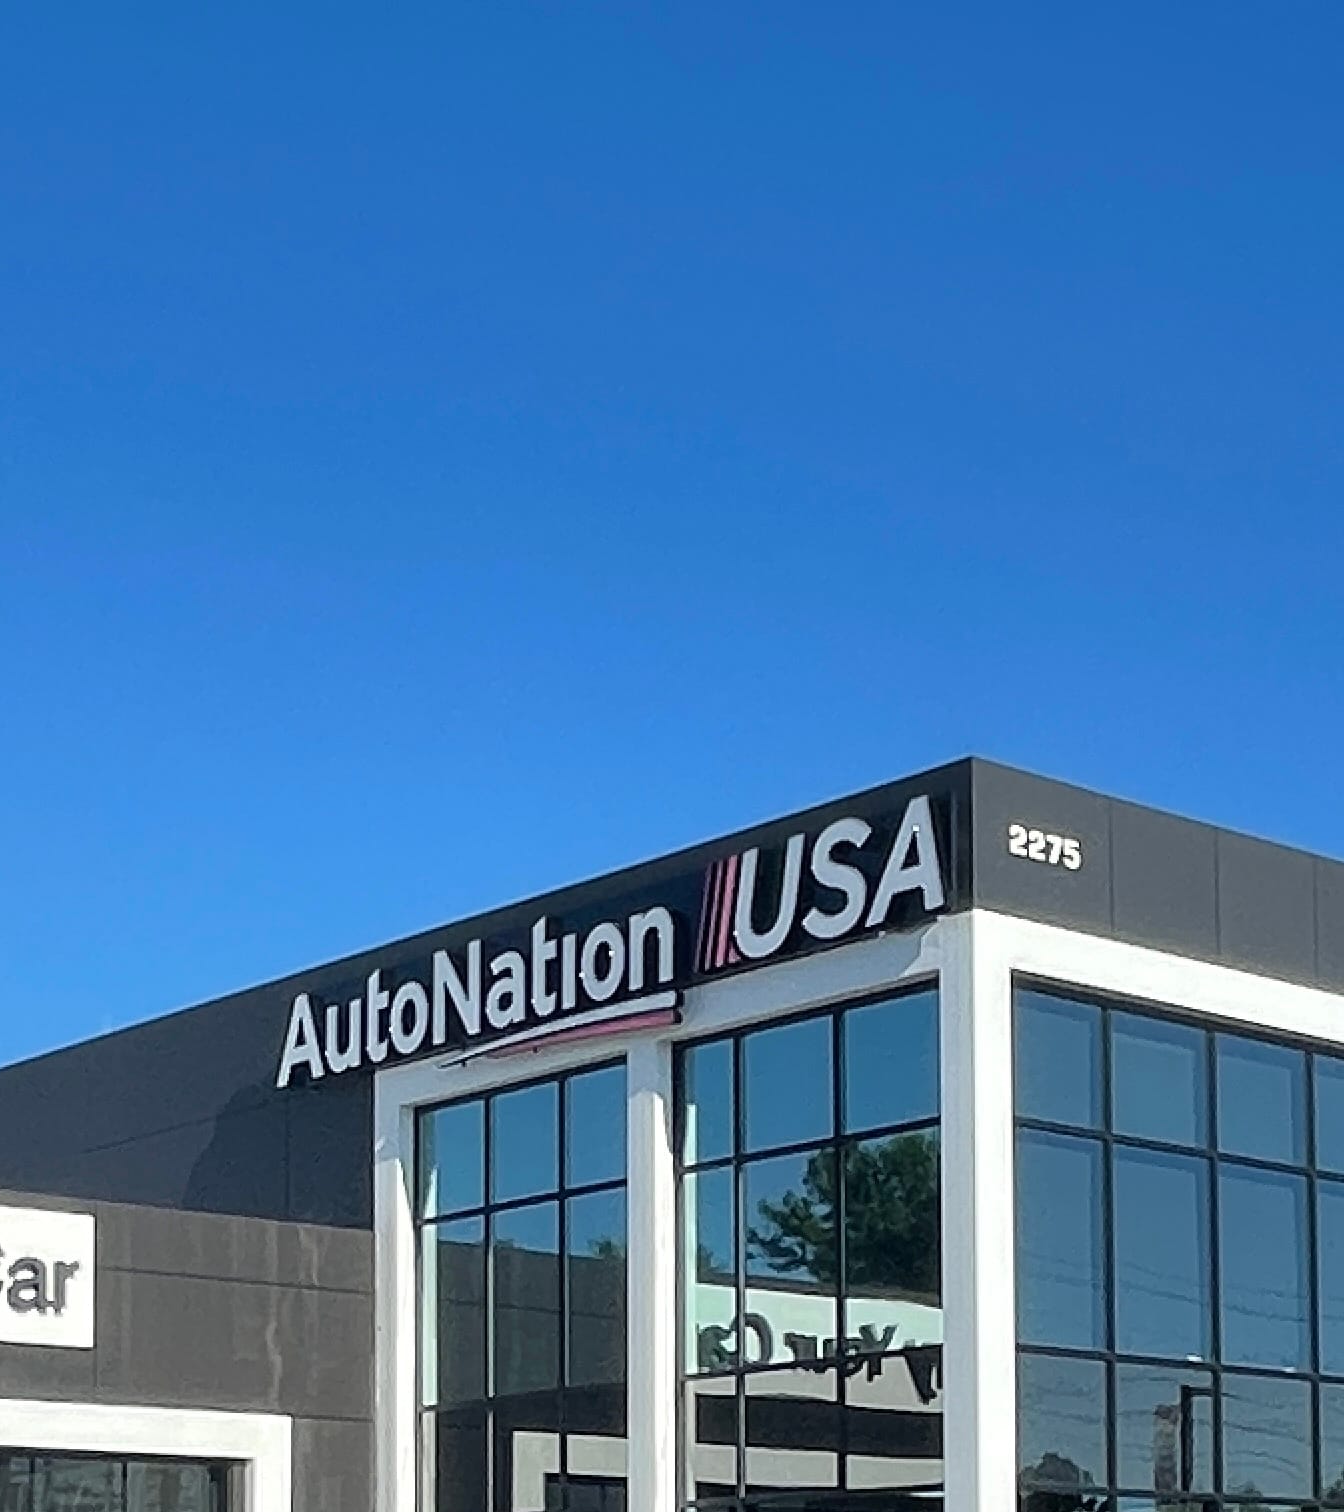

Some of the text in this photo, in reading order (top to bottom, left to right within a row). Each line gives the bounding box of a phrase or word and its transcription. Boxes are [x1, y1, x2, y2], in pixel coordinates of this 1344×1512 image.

[1008, 823, 1082, 870] 2275
[276, 796, 944, 1089] AutoNation USA
